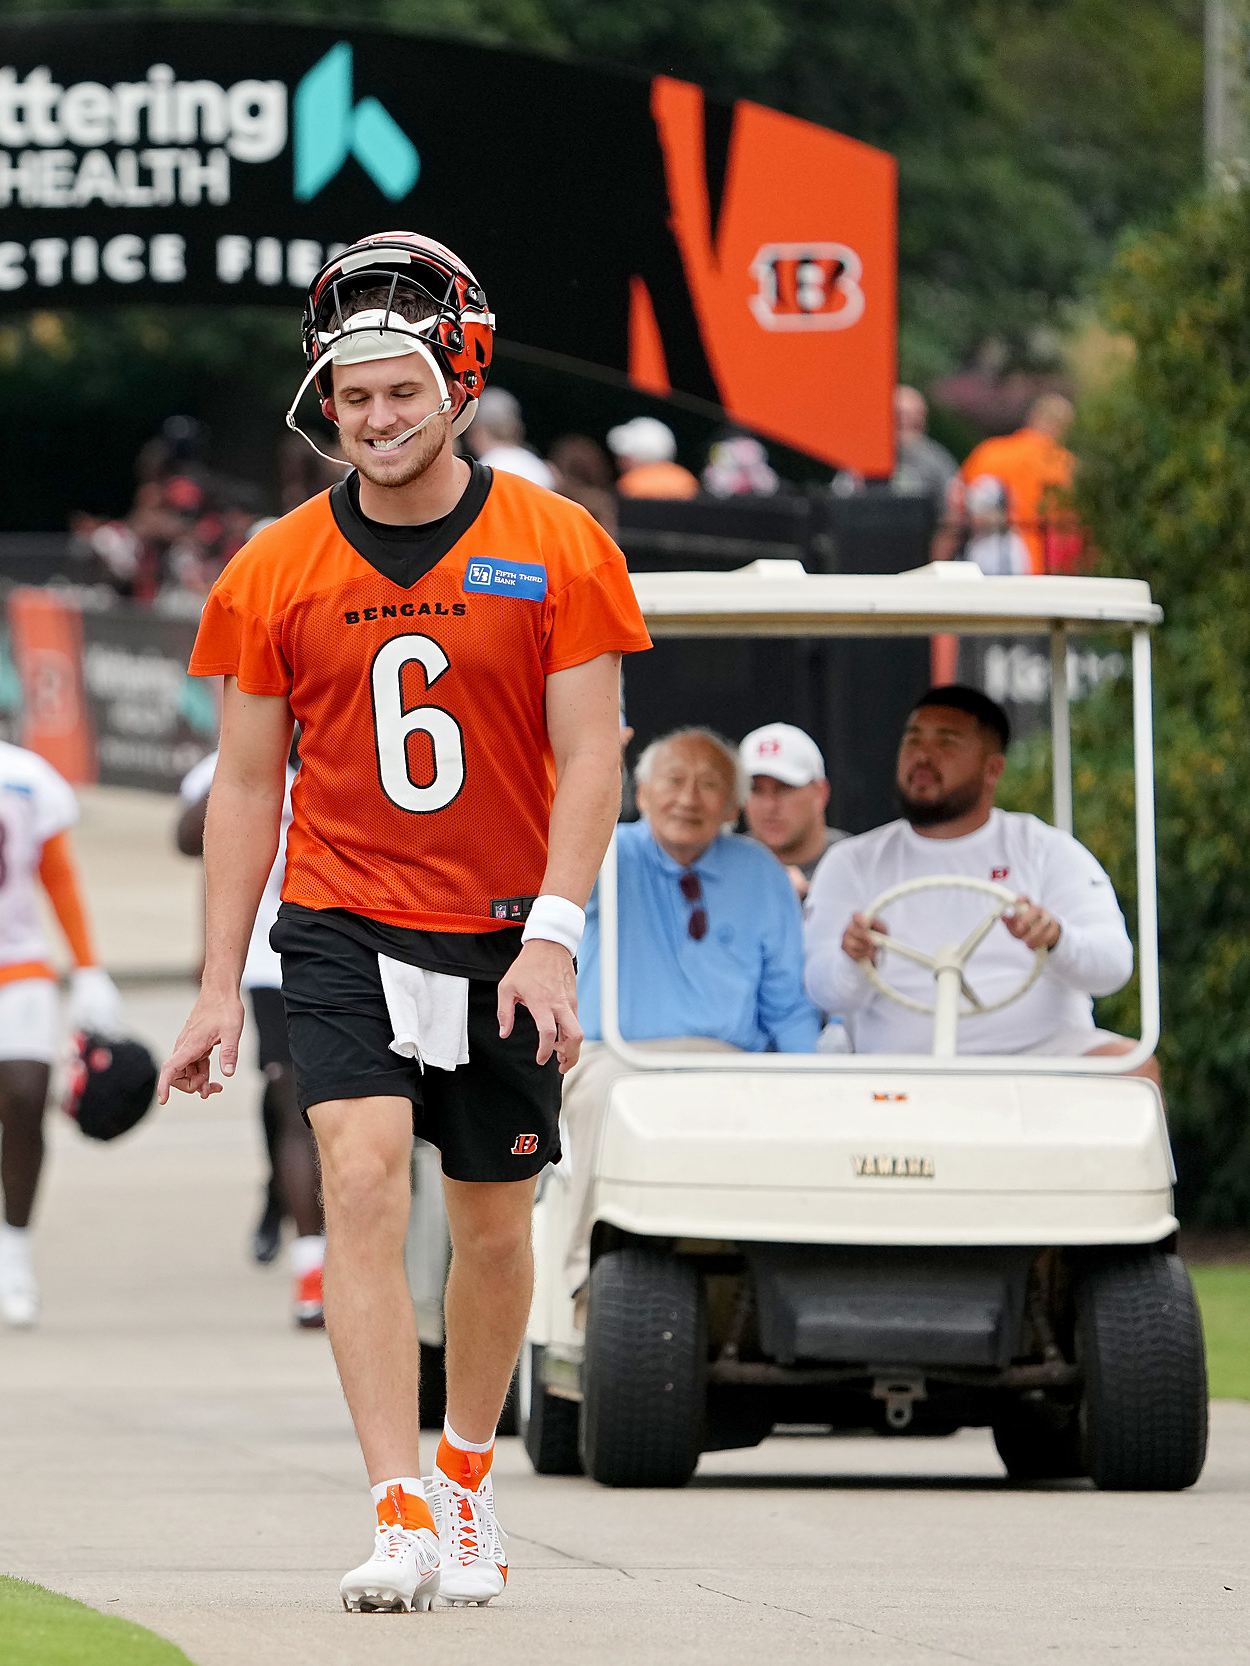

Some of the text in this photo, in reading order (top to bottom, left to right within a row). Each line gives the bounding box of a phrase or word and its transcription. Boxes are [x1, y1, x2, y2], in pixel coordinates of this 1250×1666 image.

[494, 576, 516, 586] BANK
[495, 569, 543, 583] FIFTH THIRD
[344, 602, 466, 625] BENGALS
[369, 631, 467, 815] 6
[852, 1154, 934, 1177] YAMAHA
